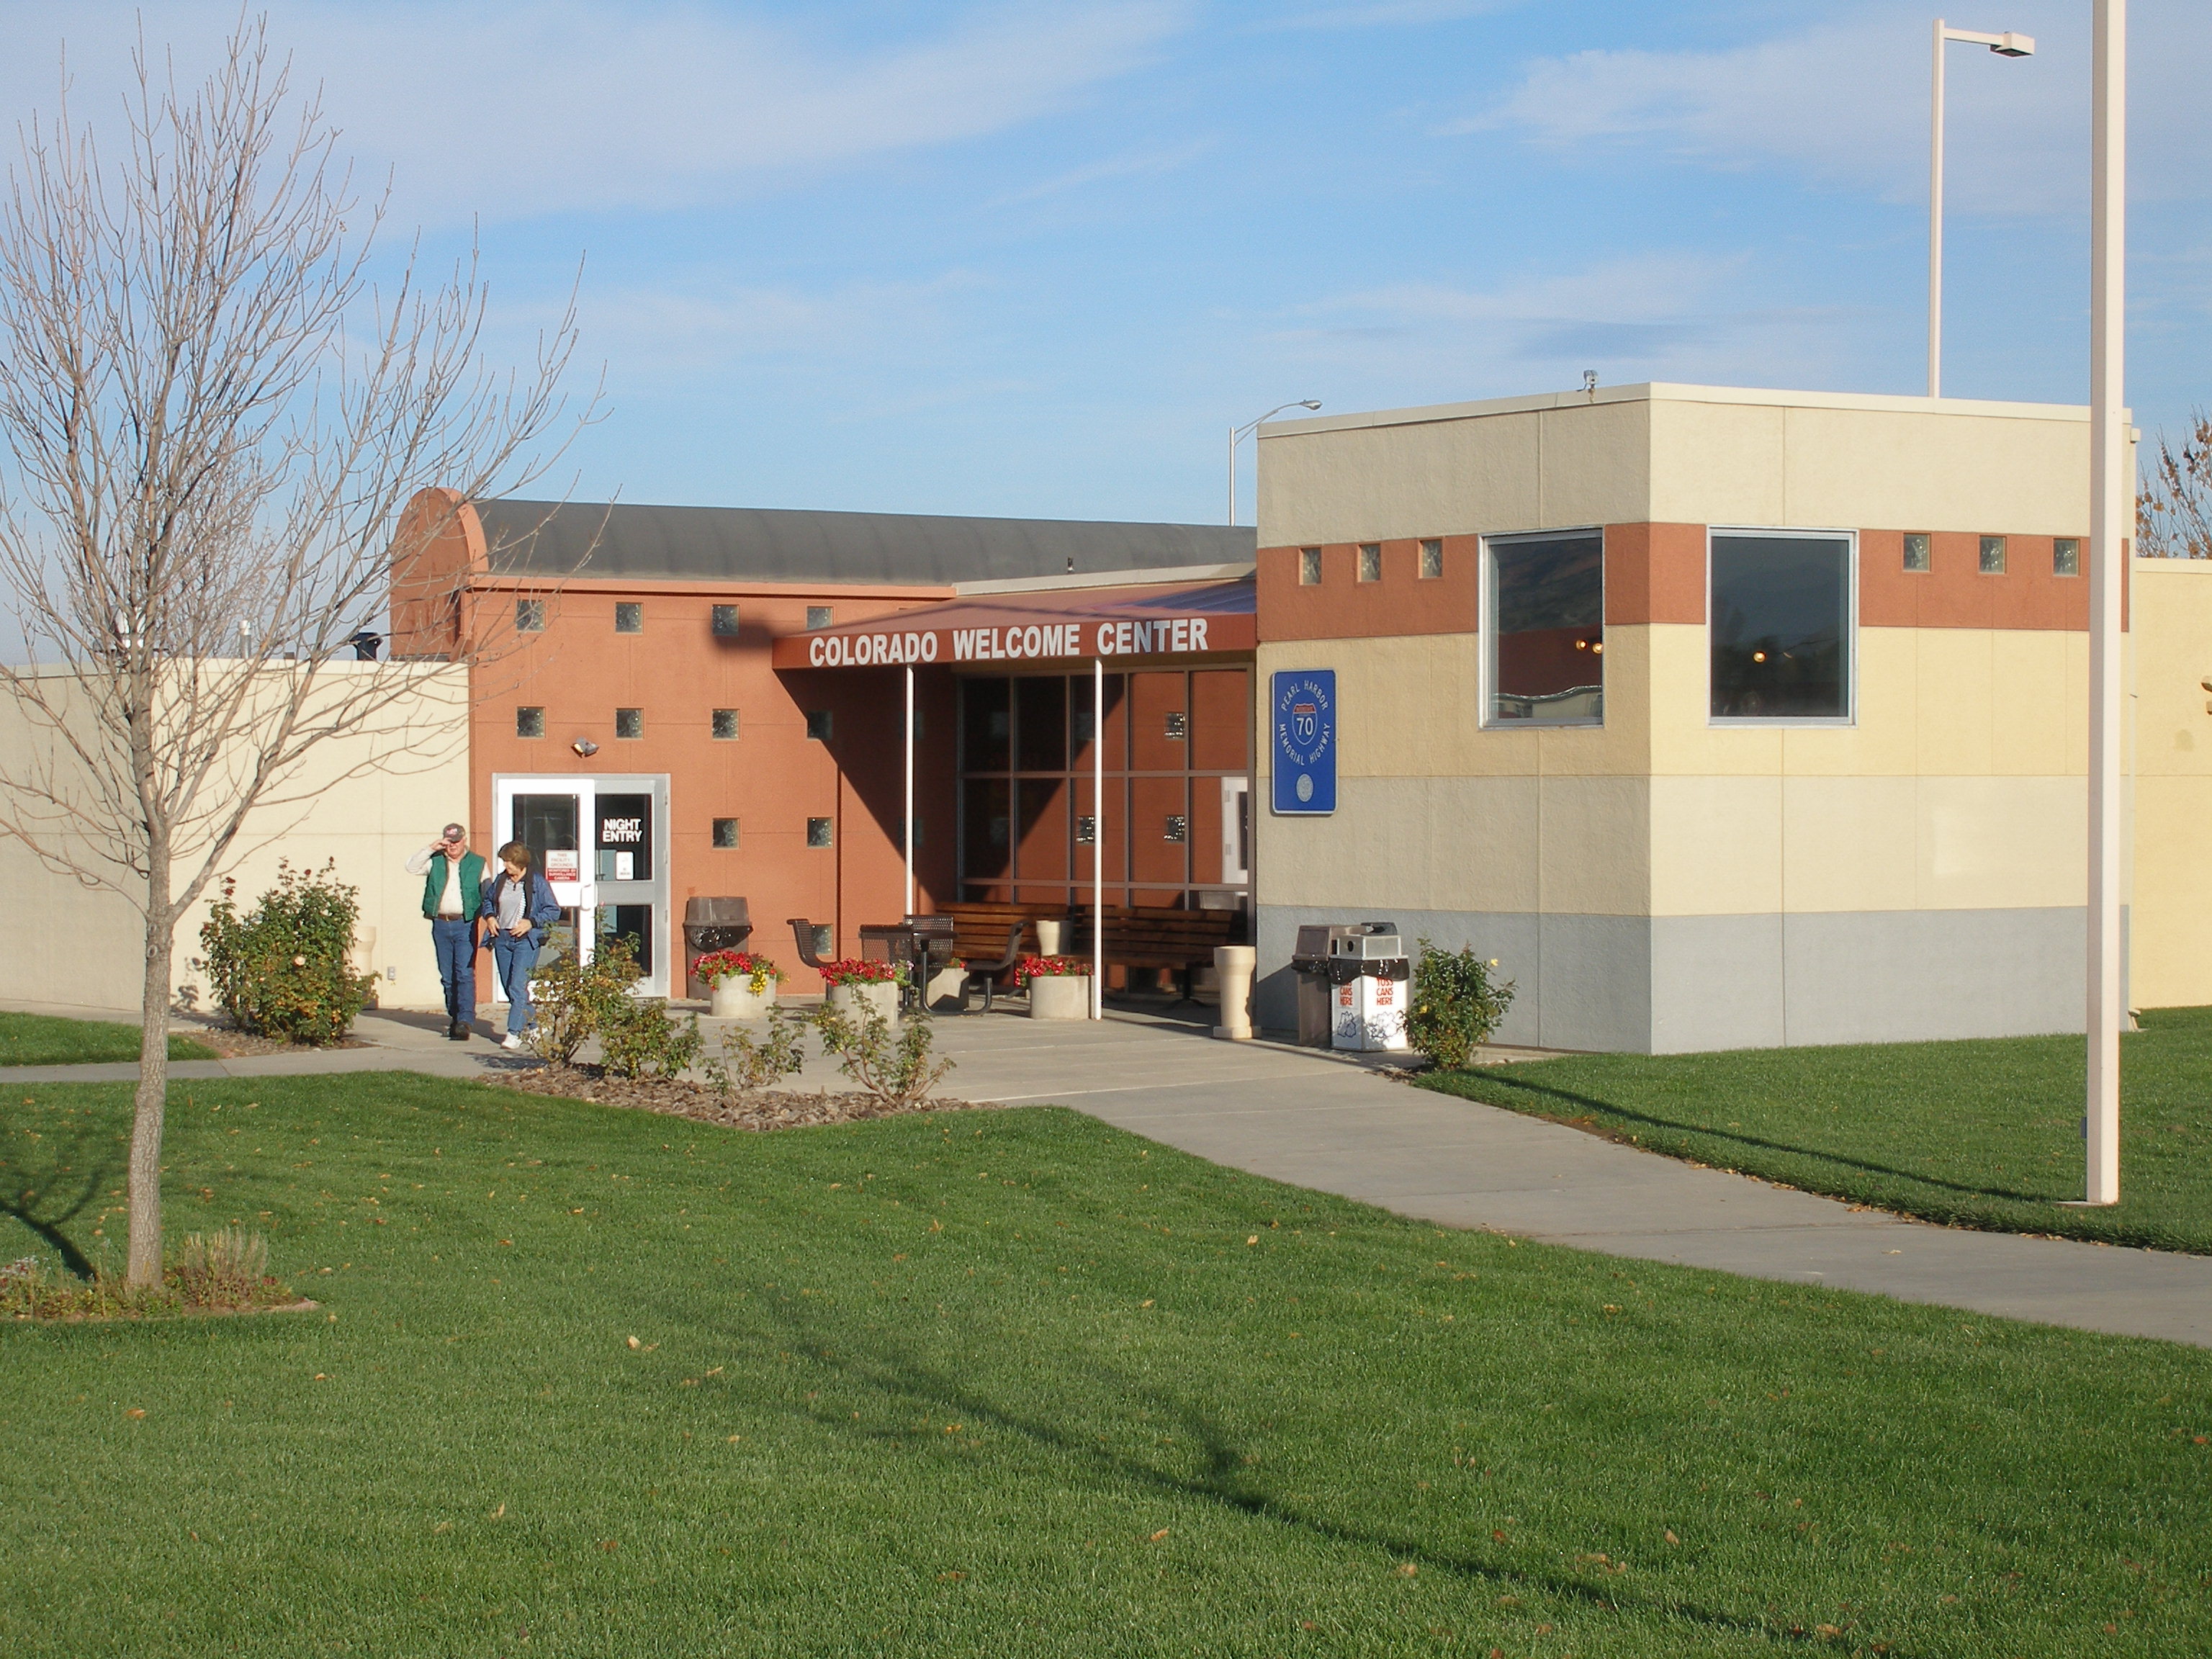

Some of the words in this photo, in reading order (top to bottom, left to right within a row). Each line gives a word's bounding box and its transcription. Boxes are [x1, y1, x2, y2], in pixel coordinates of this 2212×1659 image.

[809, 631, 938, 667] COLORADO
[953, 624, 1080, 660] WELCOME
[1097, 618, 1208, 655] CENTER
[1281, 683, 1300, 711] PEARL
[1304, 680, 1328, 710] HARBOR
[1297, 717, 1313, 735] 70
[1280, 723, 1305, 766] MEMORIAL
[1309, 723, 1331, 763] HIGHWAY
[604, 818, 642, 830] NIGHT
[603, 830, 642, 842] ENTRY
[1377, 977, 1393, 986] TOSS
[1377, 987, 1393, 996] CANS
[1340, 997, 1352, 1005] HERE
